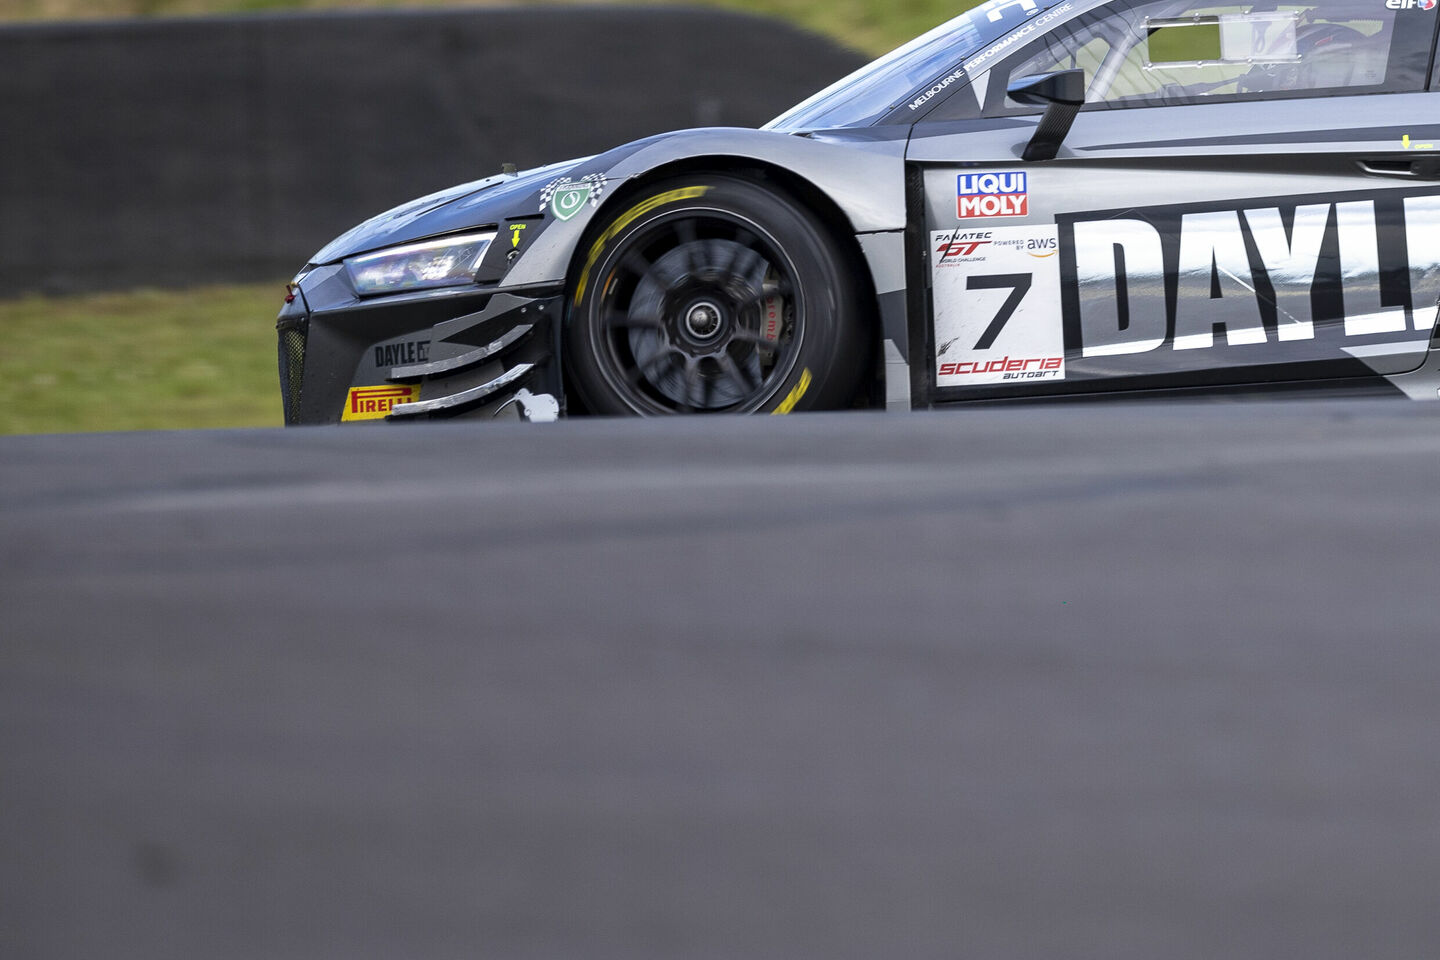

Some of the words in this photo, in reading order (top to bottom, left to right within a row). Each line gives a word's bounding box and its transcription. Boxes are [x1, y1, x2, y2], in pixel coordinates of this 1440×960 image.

[908, 68, 965, 111] MELBOURNE
[963, 23, 1036, 72] PERFORMANCE
[1035, 2, 1074, 27] CENTRE
[959, 173, 1025, 194] LIQUI
[960, 194, 1027, 216] MOLY
[935, 231, 993, 241] FANATEC
[1027, 237, 1057, 250] aws
[966, 272, 1033, 350] 7
[375, 342, 416, 367] DAYLE
[938, 356, 1064, 375] scuderia
